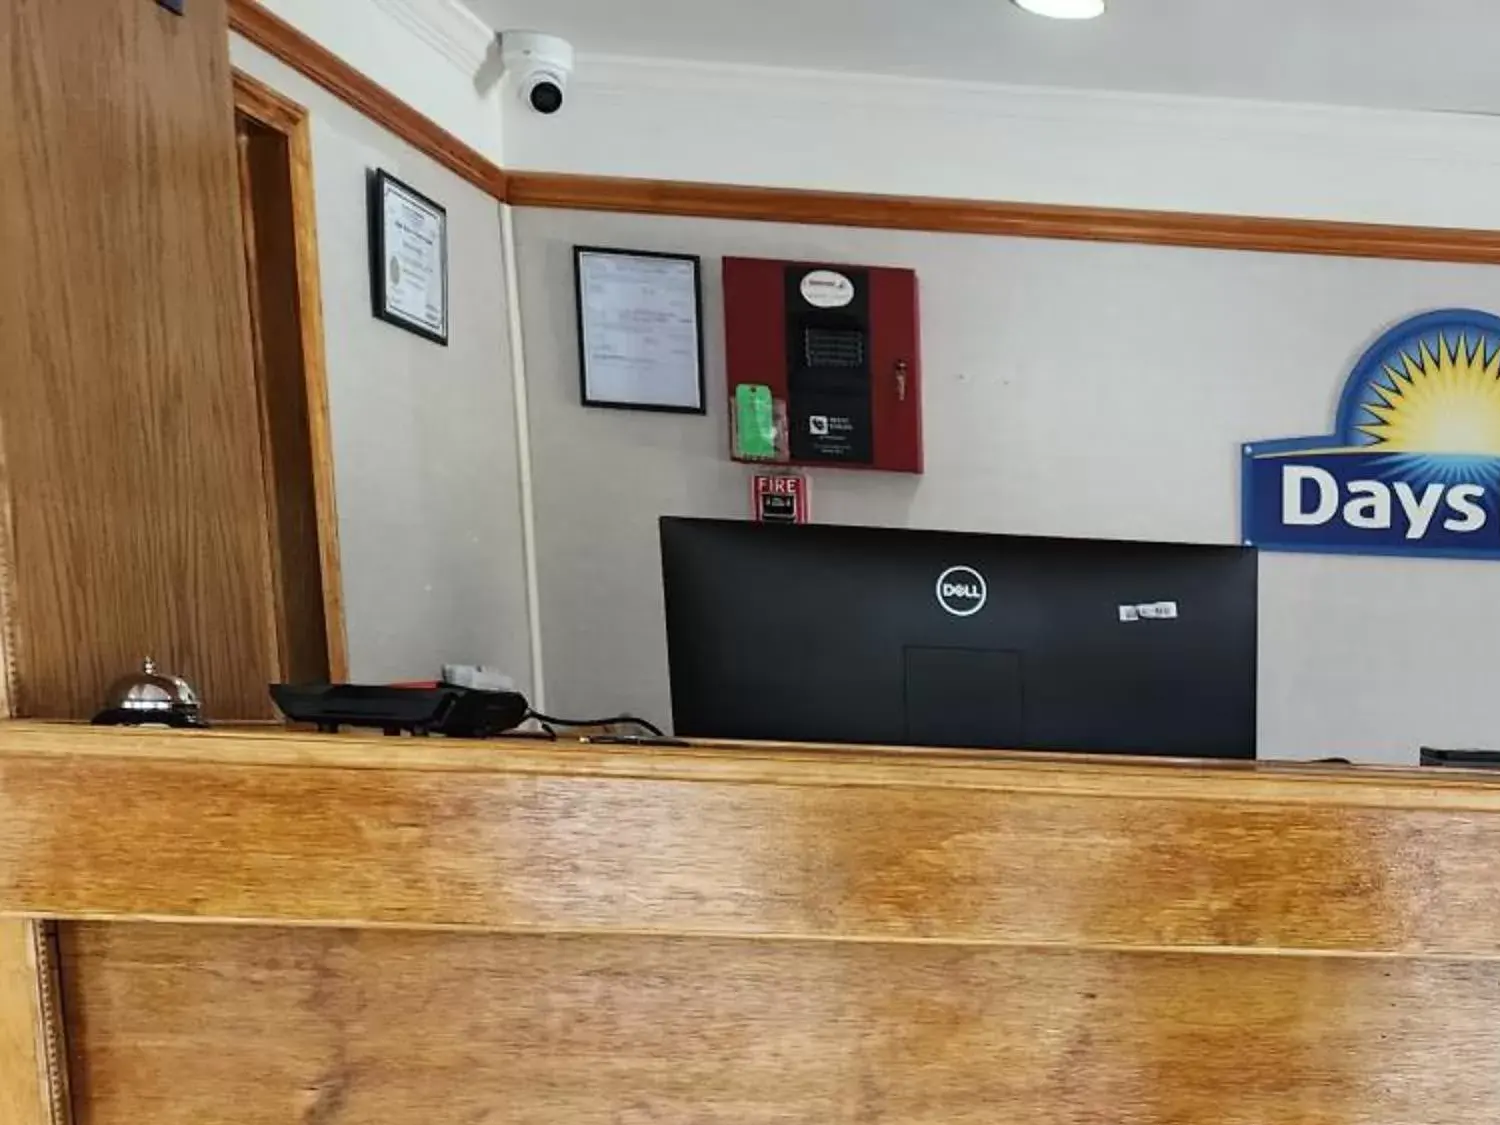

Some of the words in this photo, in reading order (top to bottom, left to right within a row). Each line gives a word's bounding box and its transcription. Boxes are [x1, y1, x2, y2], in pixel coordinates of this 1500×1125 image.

[758, 477, 796, 493] FIRE
[1282, 464, 1487, 538] Days
[943, 583, 981, 598] DELL
